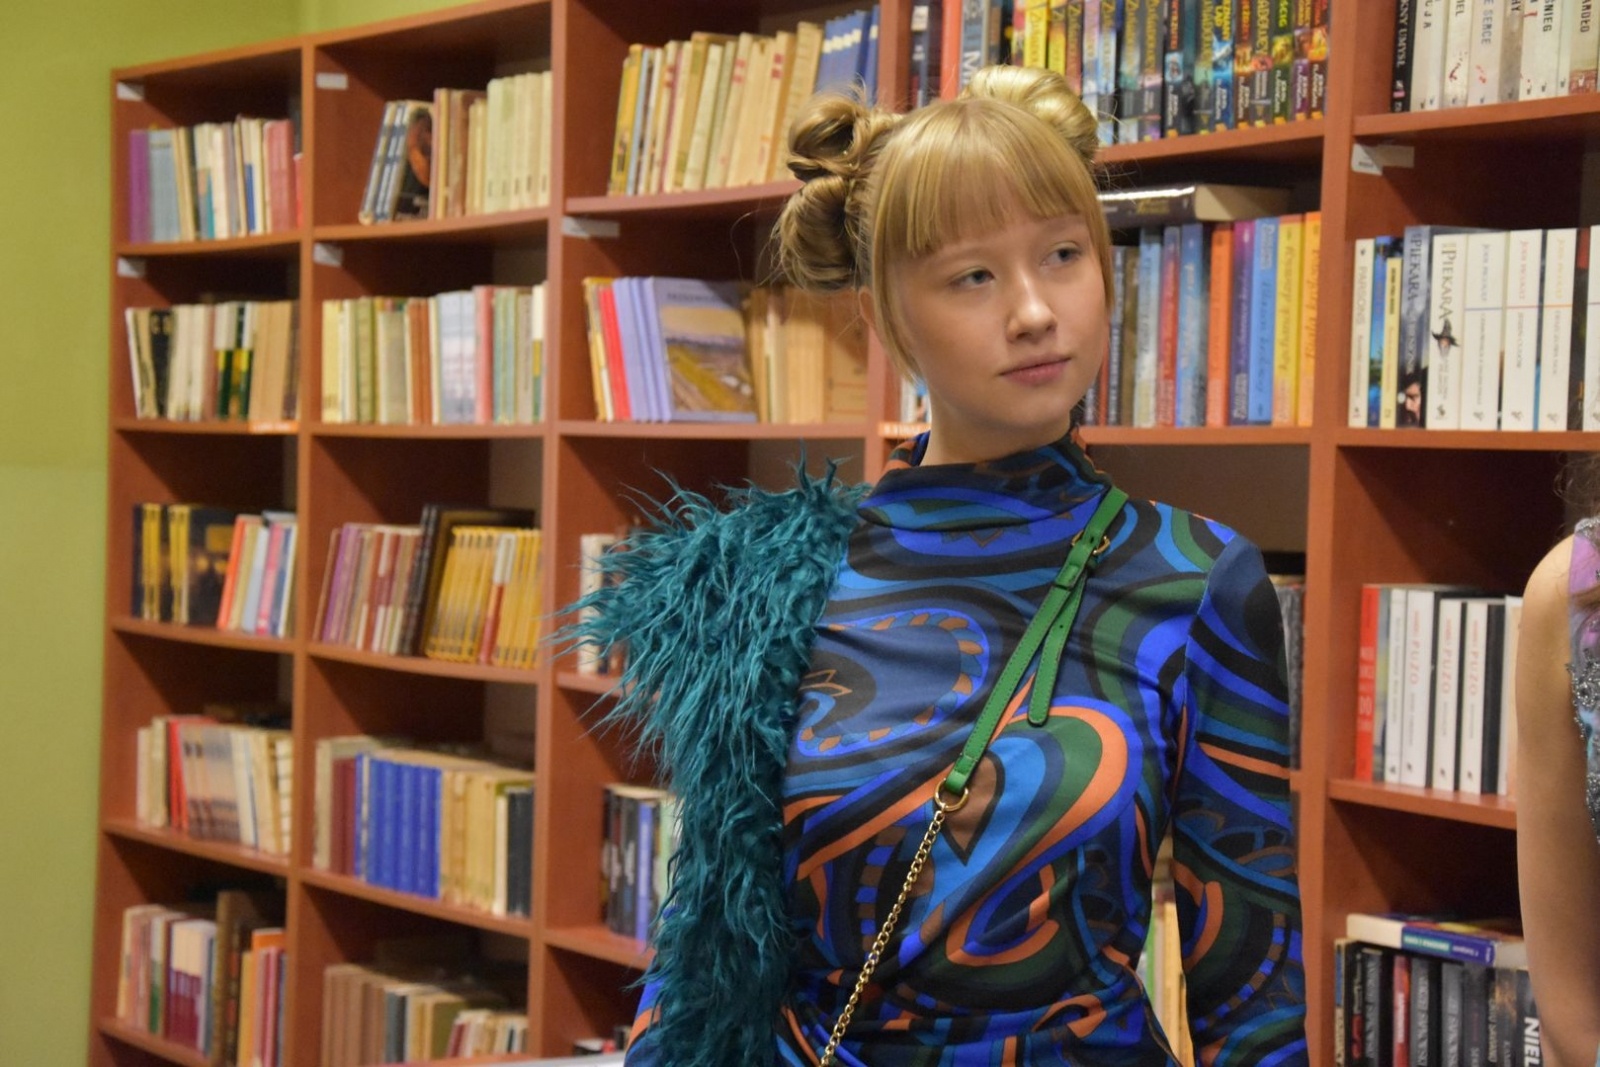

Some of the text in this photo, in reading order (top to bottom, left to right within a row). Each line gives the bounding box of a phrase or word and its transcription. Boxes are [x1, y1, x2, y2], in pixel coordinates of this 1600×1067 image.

[1480, 9, 1494, 45] SERCE
[1408, 239, 1422, 301] PIEKARA
[1438, 250, 1457, 320] PIEKARA
[1409, 640, 1420, 686] PUZO
[1442, 648, 1452, 694] PUZO
[1469, 651, 1479, 696] PUZO
